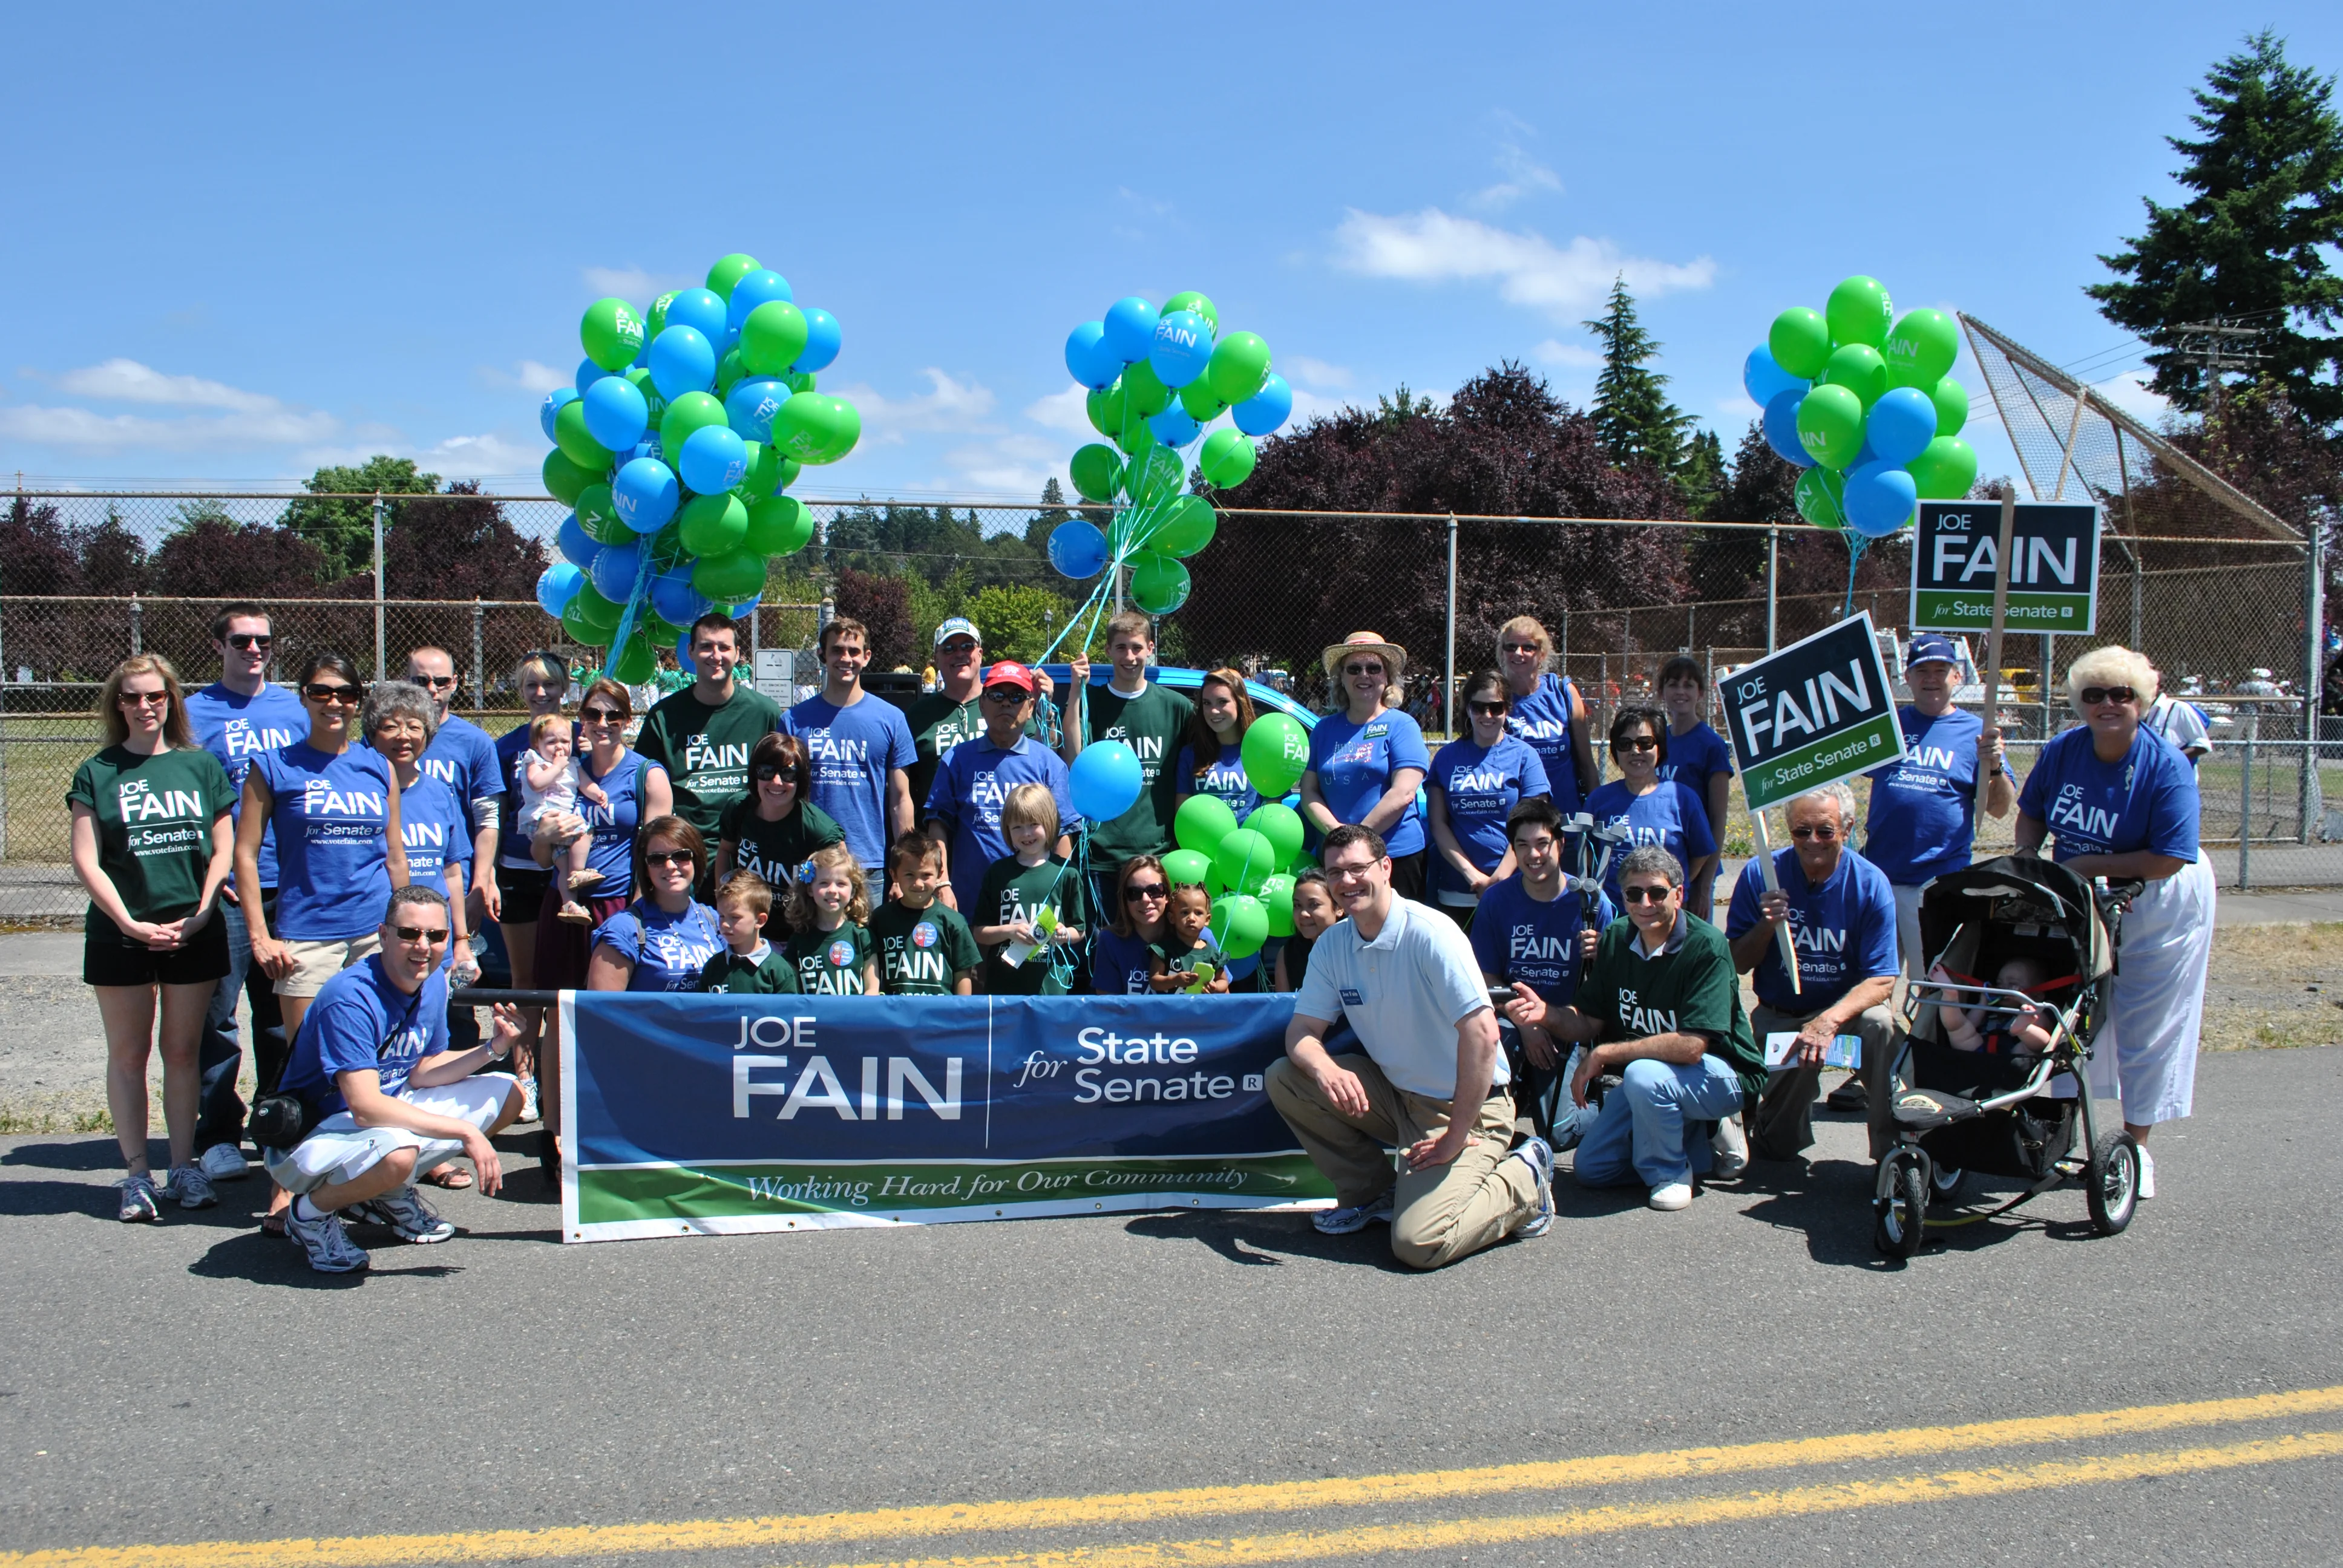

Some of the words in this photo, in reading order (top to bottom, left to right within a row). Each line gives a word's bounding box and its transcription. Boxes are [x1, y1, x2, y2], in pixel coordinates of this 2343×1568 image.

[1155, 326, 1197, 348] FAIN
[1889, 338, 1919, 357] AIN
[1799, 431, 1826, 446] AIN
[732, 485, 761, 506] AIN
[1936, 514, 1971, 530] JOE
[1933, 535, 2077, 584] FAIN
[1932, 604, 1951, 619] for
[1953, 601, 1994, 616] State
[1737, 676, 1767, 705] JOE
[1740, 658, 1872, 757] FAIN
[224, 718, 249, 733] JOE
[808, 727, 830, 738] JOE
[936, 723, 958, 734] JOE
[1106, 726, 1126, 739] JOE
[226, 728, 292, 756] FAIN
[686, 734, 709, 746] JOE
[1903, 734, 1919, 743] OE
[686, 743, 748, 770] FAIN
[808, 739, 867, 762] FAIN
[1901, 745, 1954, 770] AIN
[820, 766, 859, 779] Senate
[973, 771, 994, 781] JOE
[1142, 768, 1155, 777] ate
[1452, 765, 1472, 774] JOE
[1761, 778, 1775, 796] for
[1775, 762, 1814, 785] State
[1814, 740, 1867, 769] Senate
[306, 780, 332, 791] JOE
[685, 779, 698, 789] for
[700, 776, 741, 787] Senate
[1449, 773, 1504, 791] FAIN
[1898, 770, 1938, 785] Senate
[119, 779, 149, 797] JOE
[972, 782, 1018, 804] FAI
[2059, 783, 2085, 800] JOE
[120, 791, 203, 823] FAIN
[304, 791, 383, 815] FAIN
[1460, 799, 1496, 808] Senate
[1609, 815, 1630, 825] JOE
[2050, 796, 2119, 838] FAIN
[304, 825, 321, 837] for
[323, 823, 373, 835] Senate
[127, 835, 142, 851] for
[143, 828, 196, 845] Senate
[739, 836, 758, 854] JOE
[134, 845, 200, 856] www.votefain.com
[1000, 888, 1020, 904] JOE
[1788, 908, 1805, 923] OE
[1512, 924, 1534, 937] JOE
[658, 936, 681, 947] JOE
[883, 936, 903, 952] JOE
[1511, 937, 1571, 961] FAIN
[799, 955, 823, 972] JOE
[885, 951, 943, 981] FAIN
[1521, 966, 1559, 978] Senate
[800, 967, 863, 995] FAIN
[1129, 970, 1149, 981] JOE
[664, 980, 679, 992] for
[1619, 987, 1637, 1004] JOE
[1619, 1002, 1677, 1034] FAIN
[734, 1016, 816, 1050] JOE
[1013, 1050, 1067, 1088] for
[1076, 1027, 1198, 1065] State
[733, 1056, 963, 1120] FAIN
[1073, 1068, 1234, 1103] Senate
[747, 1175, 870, 1206] Working
[877, 1175, 961, 1197] Hard
[968, 1173, 1010, 1199] for
[1016, 1170, 1077, 1192] Our
[1084, 1166, 1248, 1190] Community
